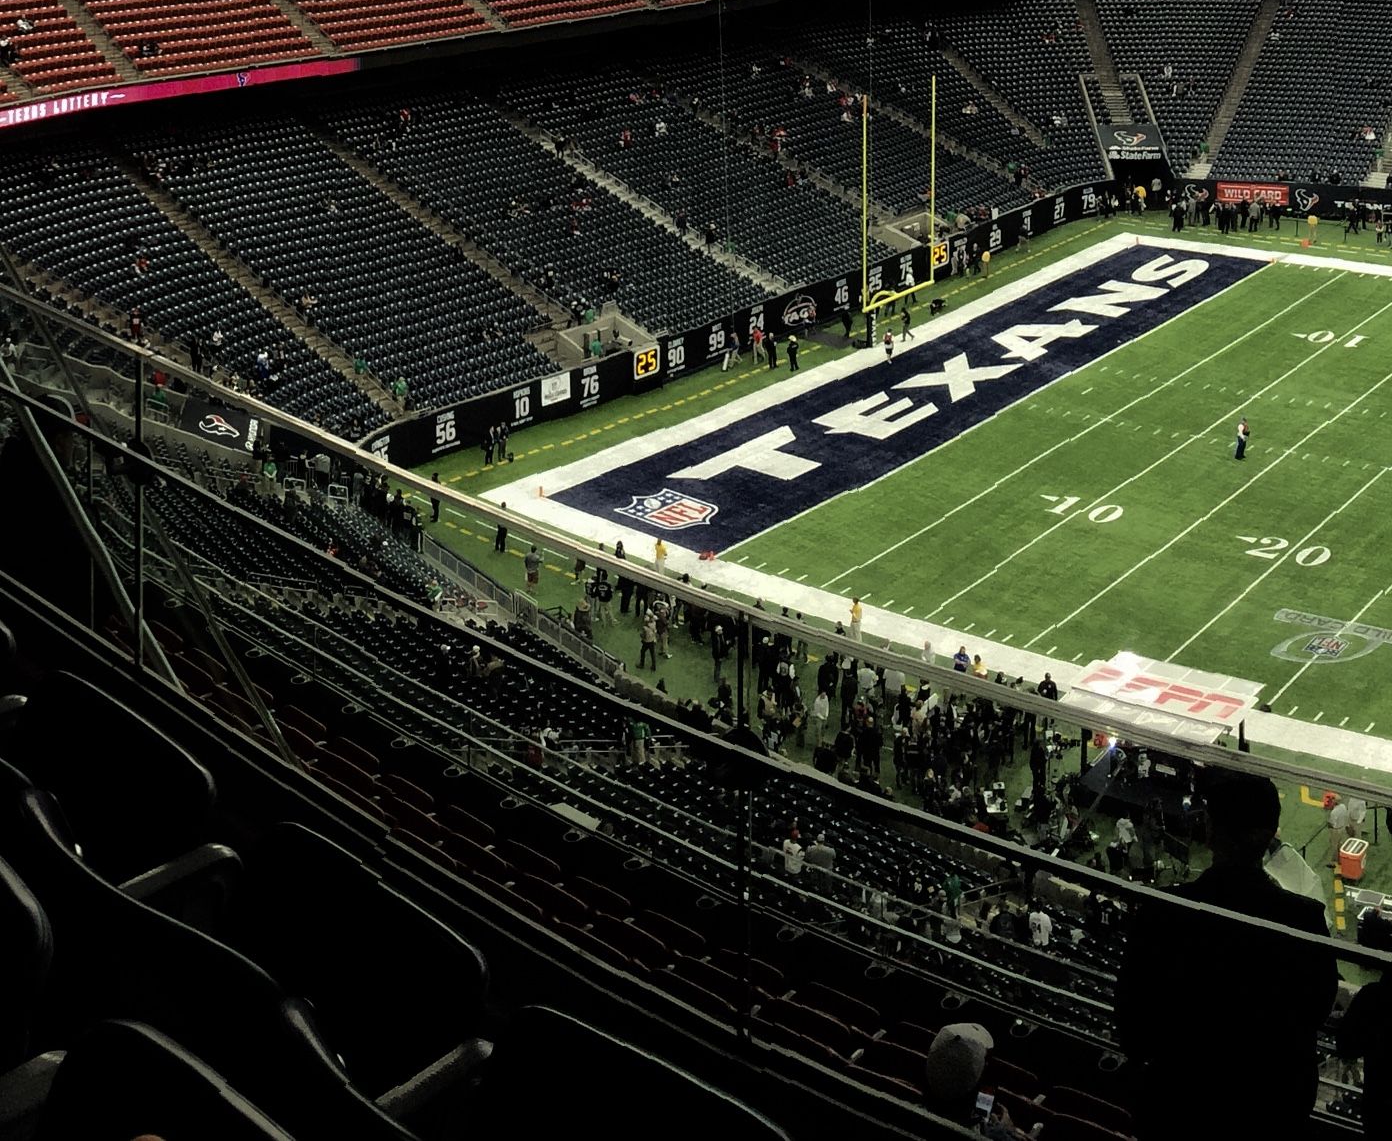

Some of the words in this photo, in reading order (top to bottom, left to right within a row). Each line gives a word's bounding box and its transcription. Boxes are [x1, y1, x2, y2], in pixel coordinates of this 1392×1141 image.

[1081, 193, 1096, 210] 79
[1224, 188, 1249, 200] WILD
[1253, 188, 1282, 201] CARD
[1053, 203, 1065, 220] 27
[834, 286, 849, 306] 46
[708, 330, 726, 352] 99
[1312, 330, 1368, 348] 10
[637, 349, 657, 376] 25
[667, 346, 685, 368] 90
[667, 252, 1210, 482] TEXANS
[581, 374, 599, 398] 76
[514, 395, 530, 419] 10
[435, 420, 456, 445] 56
[650, 502, 708, 526] NFL
[1055, 494, 1124, 523] 10
[1248, 536, 1332, 567] 20
[1081, 664, 1247, 719] ESPN
